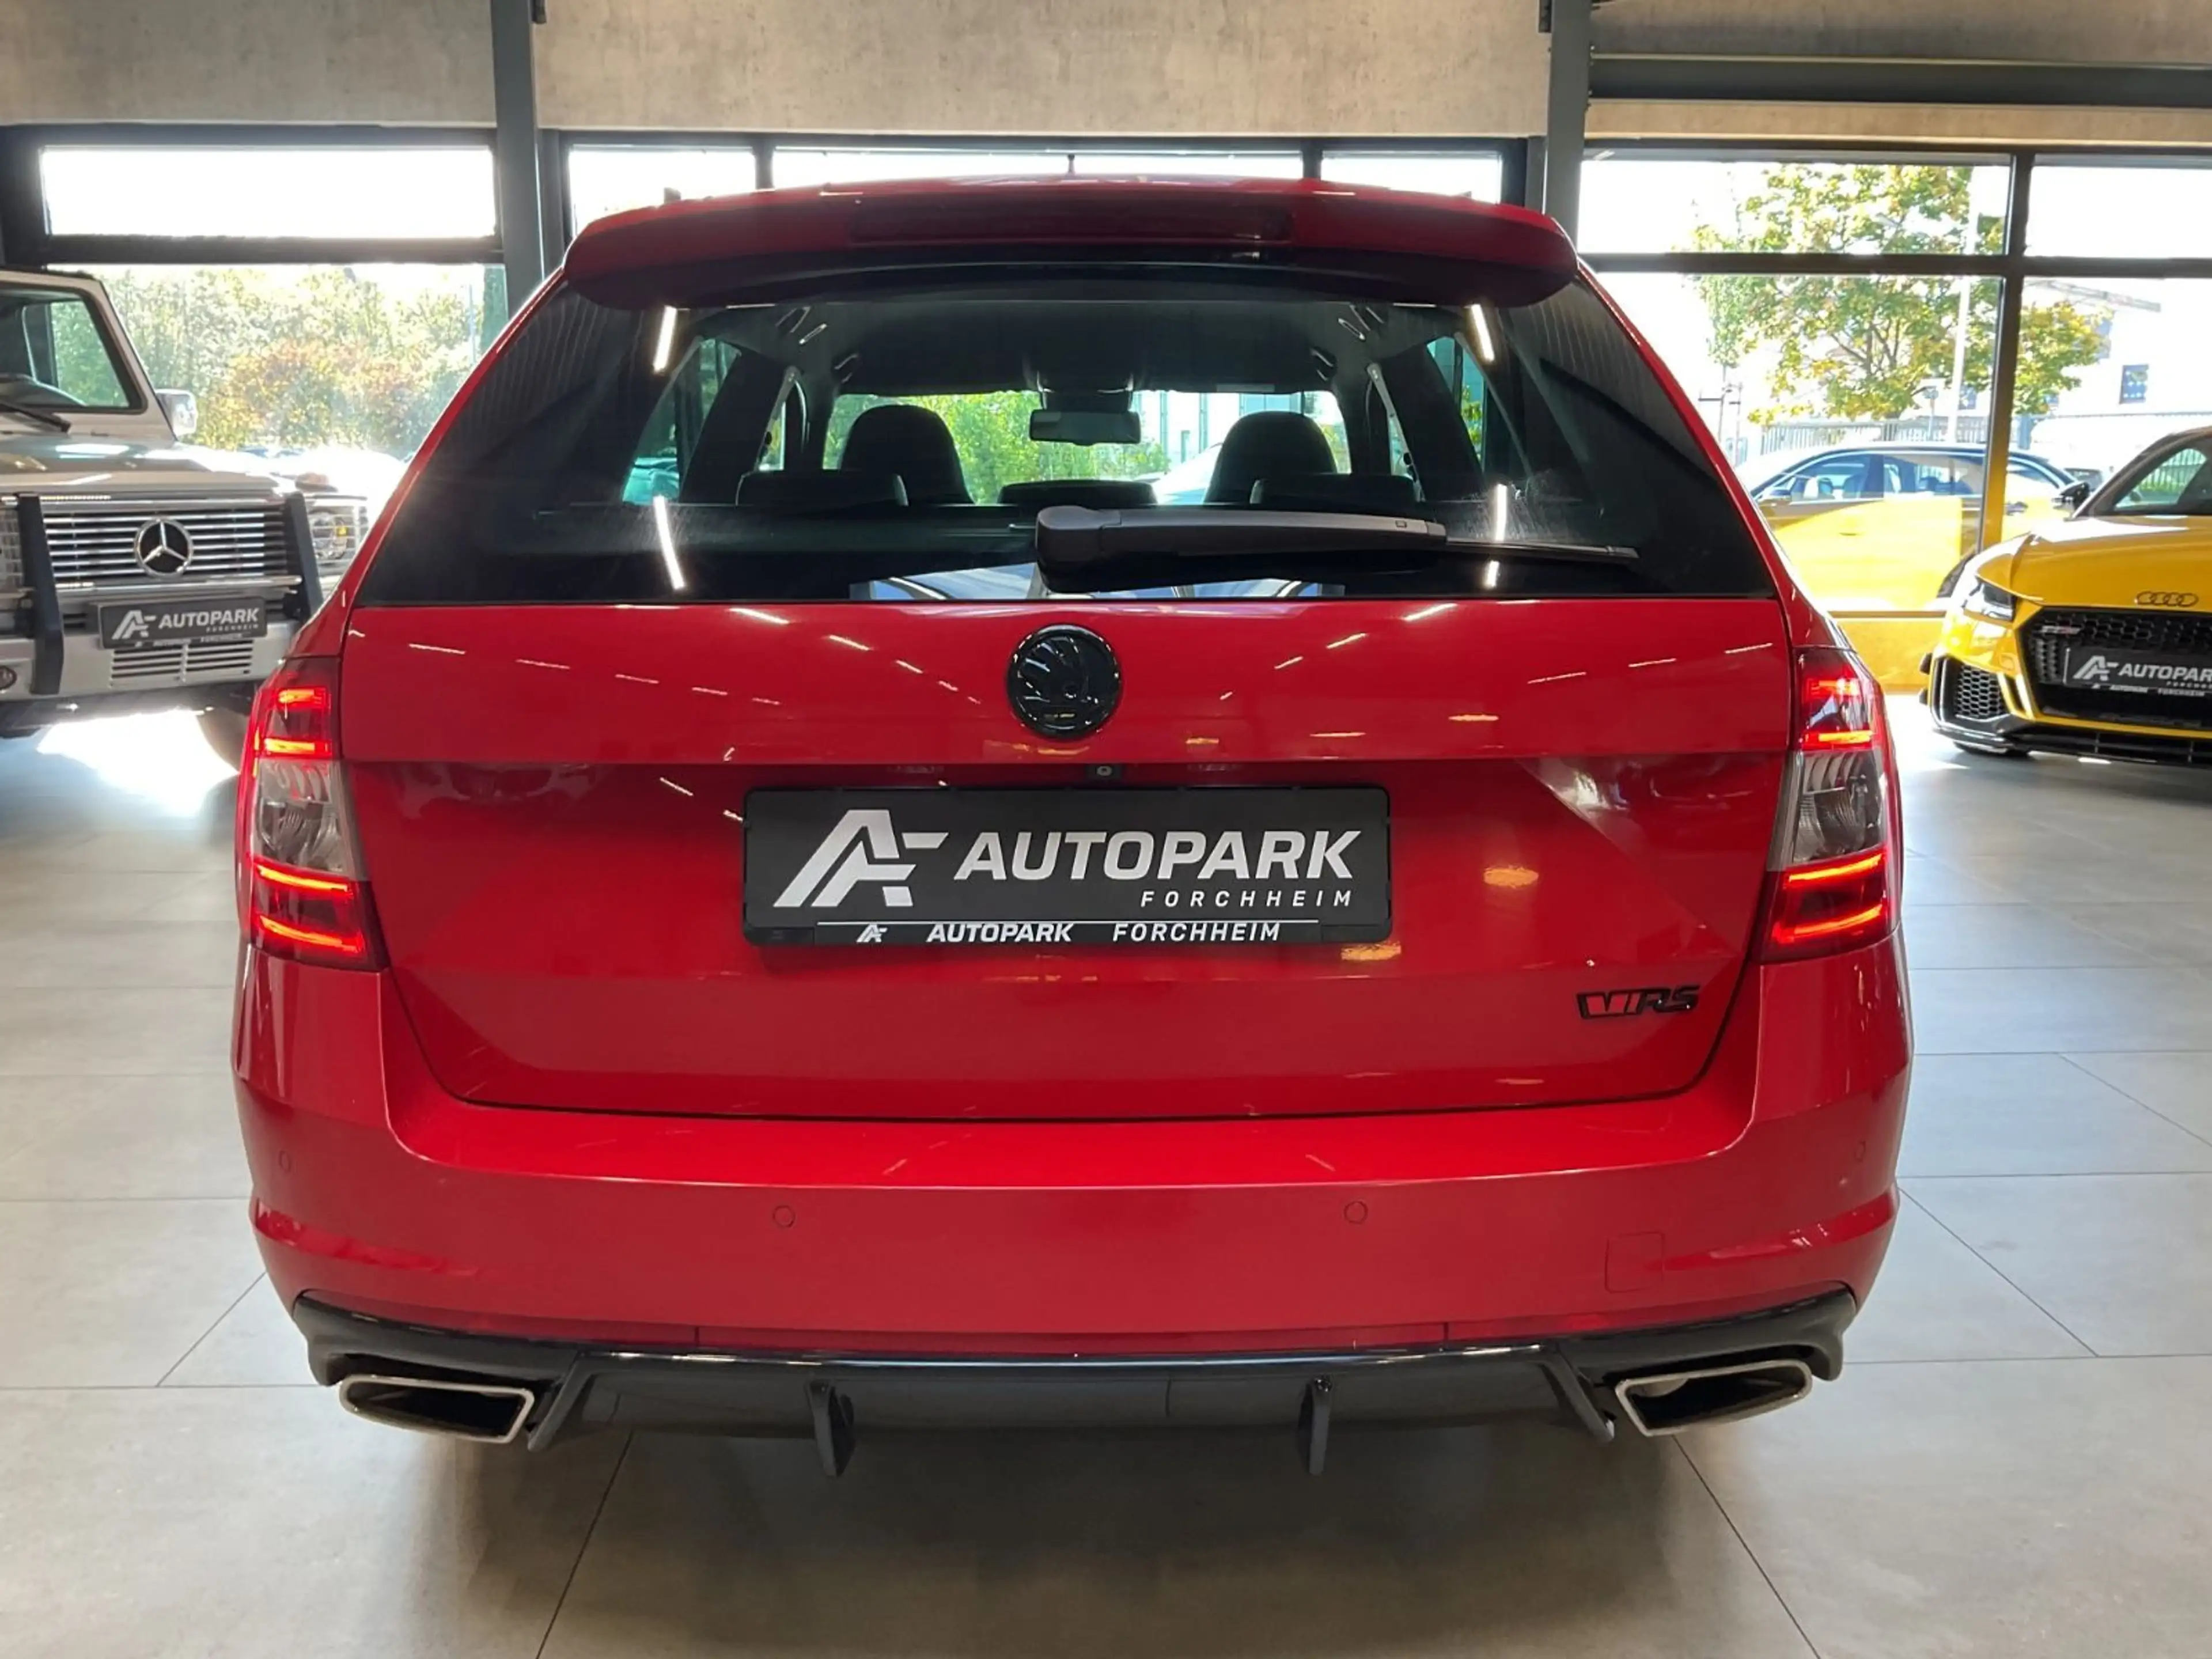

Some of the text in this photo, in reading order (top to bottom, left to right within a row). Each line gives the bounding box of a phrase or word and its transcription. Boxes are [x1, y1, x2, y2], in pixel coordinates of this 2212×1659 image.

[158, 608, 259, 629] AUTOPARK
[2118, 664, 2212, 682] AUTOPAR
[953, 831, 1361, 880] AUTOPARK
[1141, 891, 1352, 907] FORCHHEIM
[926, 923, 1074, 943] AUTOPARK
[1112, 922, 1281, 942] FORCHHEIM
